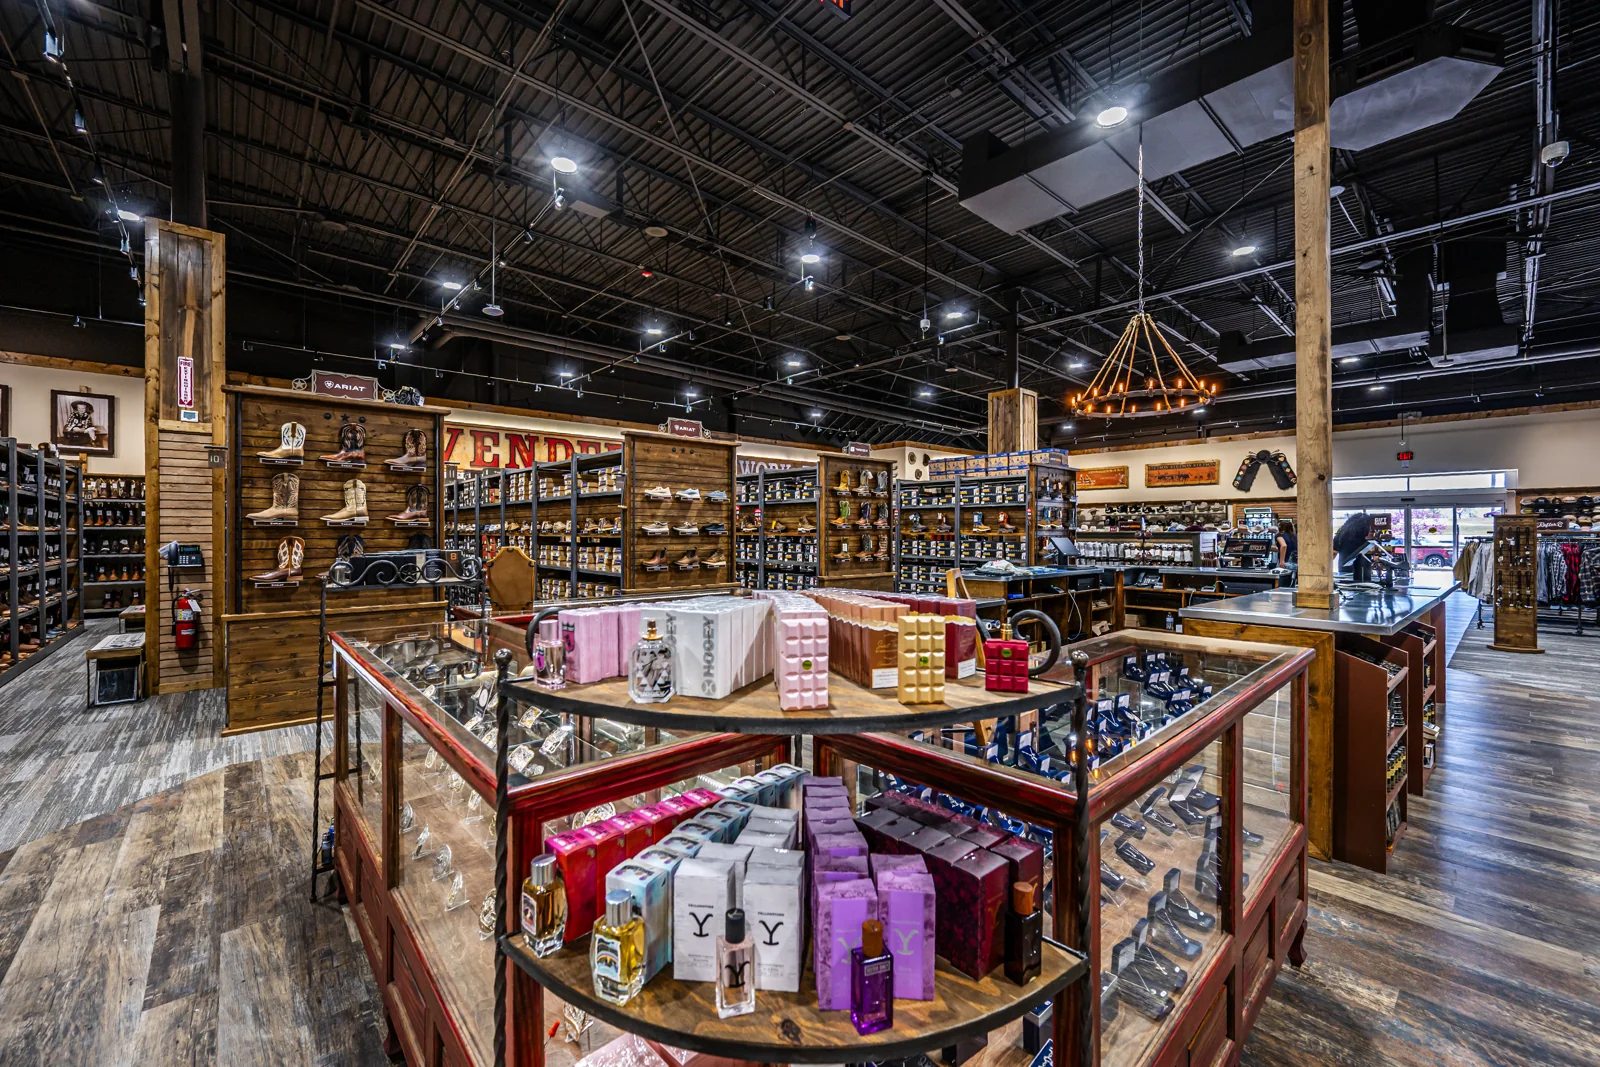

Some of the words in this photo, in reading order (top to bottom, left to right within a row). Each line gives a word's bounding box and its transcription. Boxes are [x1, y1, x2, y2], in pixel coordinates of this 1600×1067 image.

[334, 383, 366, 392] ARIAT
[210, 455, 220, 463] 10
[1399, 452, 1412, 460] EXIT
[702, 615, 715, 678] HOOEY
